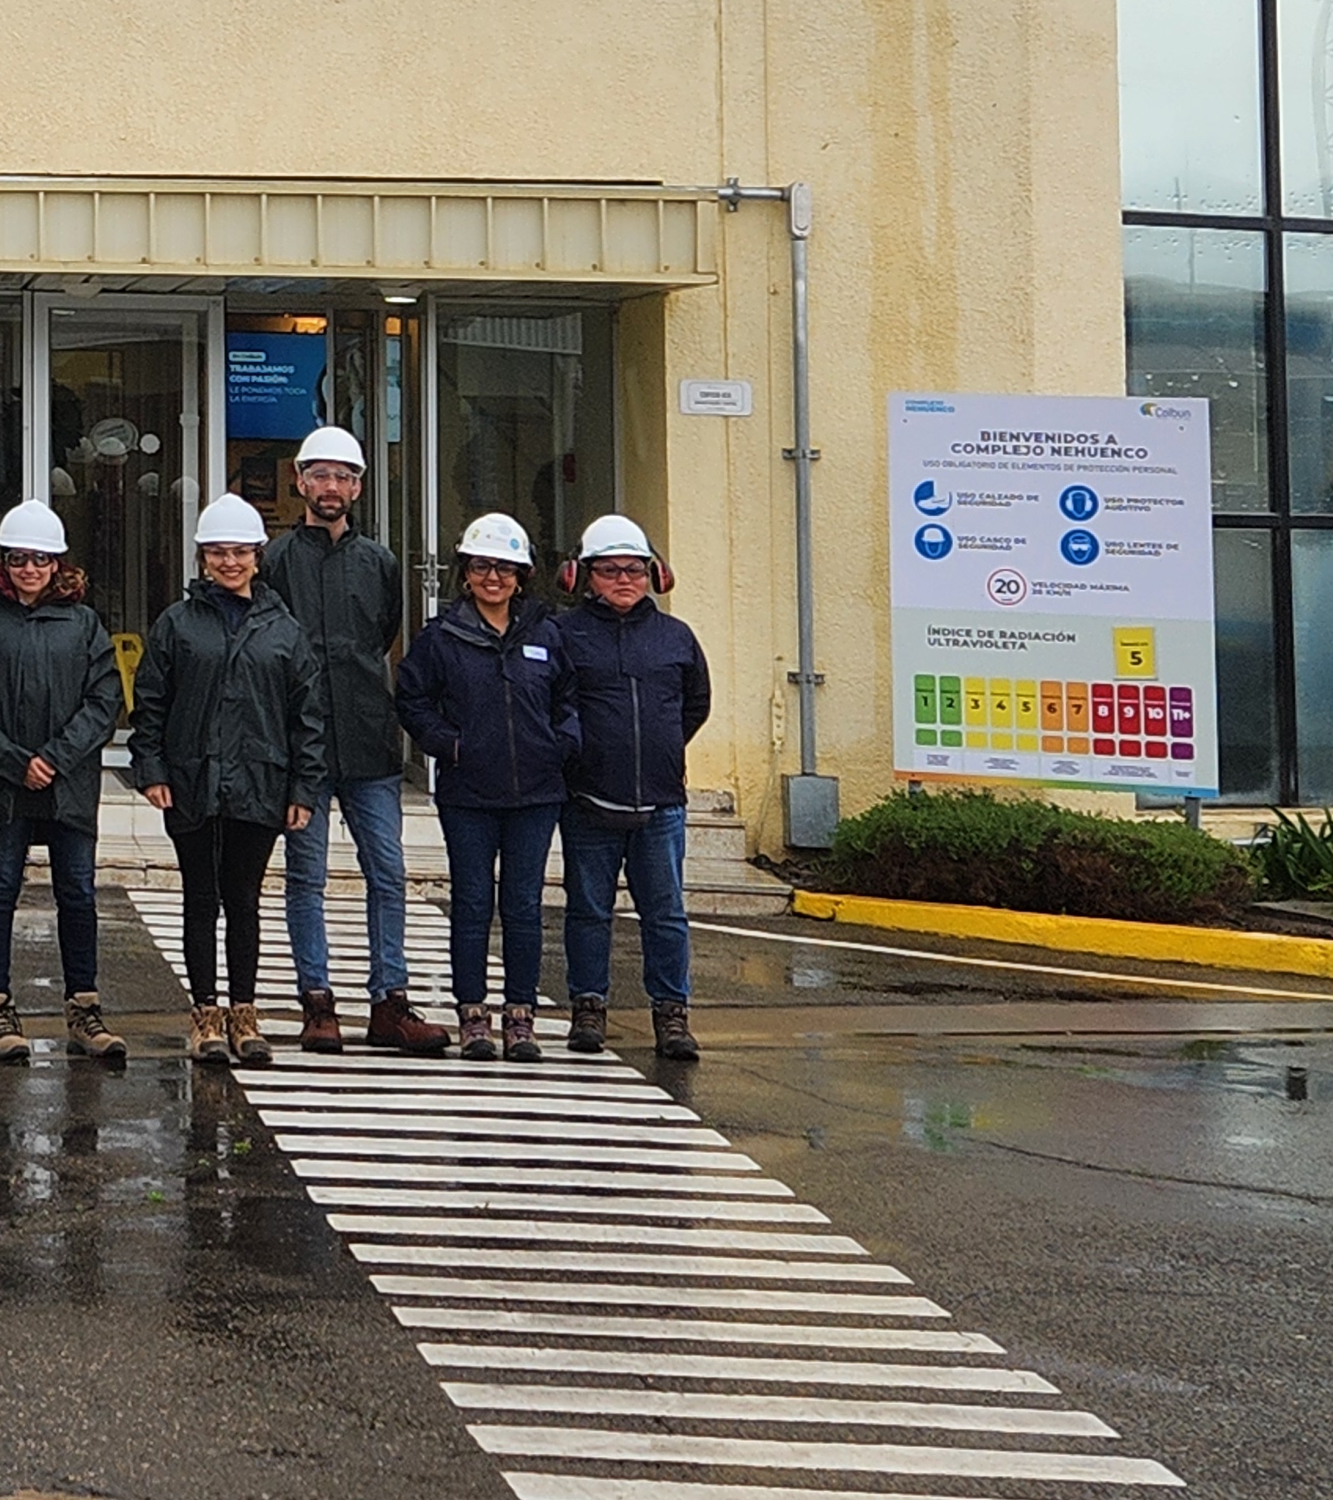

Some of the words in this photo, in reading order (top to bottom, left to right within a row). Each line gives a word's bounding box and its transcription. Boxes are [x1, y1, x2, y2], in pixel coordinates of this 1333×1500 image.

[229, 364, 295, 374] TRABAJAMOS
[229, 374, 250, 383] CON
[1155, 406, 1192, 419] Colbun
[980, 430, 1100, 445] BIENVENIDOS
[1105, 433, 1118, 446] A
[950, 442, 1045, 457] COMPLEJO
[1050, 445, 1149, 460] NEHUENCO
[922, 460, 940, 468] USO
[942, 460, 996, 470] OBLIGATORIO
[998, 461, 1009, 470] DE
[1011, 462, 1062, 472] ELEMENTOS
[1063, 463, 1075, 472] DE
[1077, 462, 1131, 474] PROTECCIÓN
[1132, 465, 1178, 475] PERSONAL
[994, 578, 1021, 595] 20
[1031, 581, 1088, 590] VELOCIDAD
[927, 624, 973, 638] ÍNDICE
[976, 629, 994, 639] DE
[998, 630, 1077, 643] RADIACIÓN
[927, 638, 1028, 651] ULTRAVIOLETA
[1129, 651, 1143, 666] 5
[921, 695, 930, 707] 1
[945, 697, 956, 709] 2
[970, 698, 981, 710] 3
[995, 700, 1007, 711] 4
[1021, 701, 1032, 713] 5
[1046, 702, 1058, 714] 6
[1071, 704, 1082, 715] 7
[1097, 705, 1109, 717] 8
[1123, 706, 1134, 718] 9
[1147, 707, 1164, 719] 10
